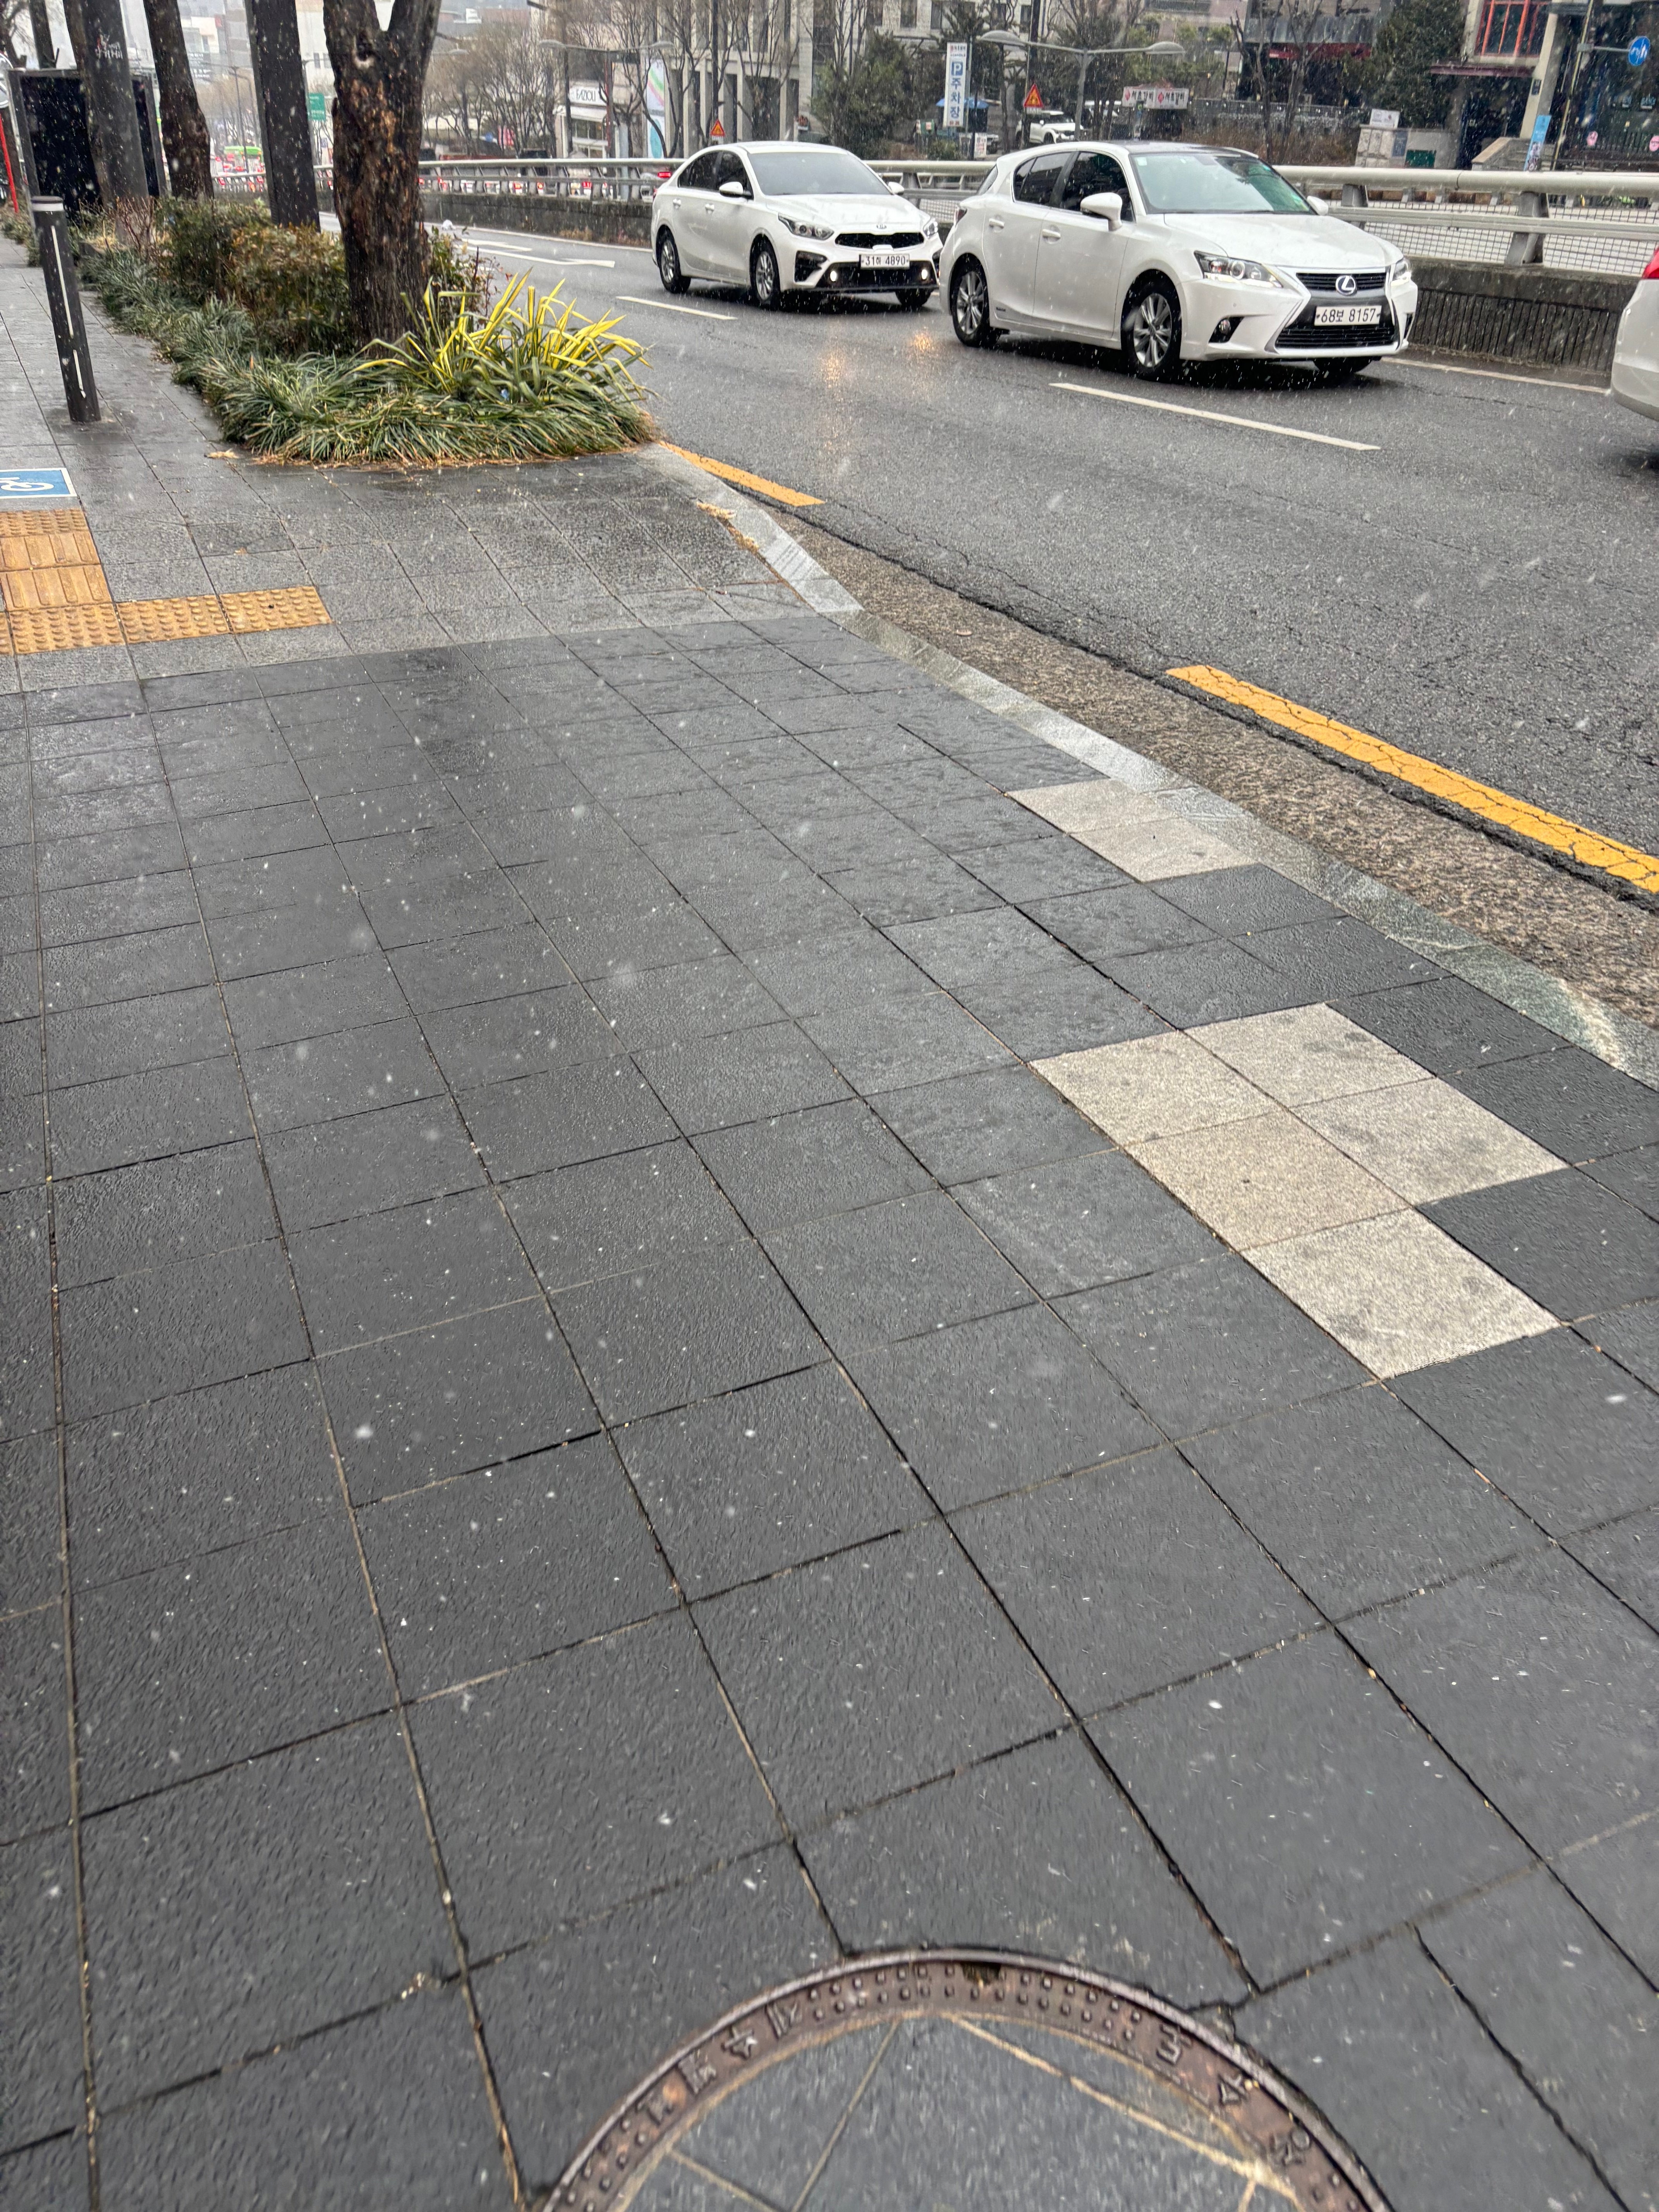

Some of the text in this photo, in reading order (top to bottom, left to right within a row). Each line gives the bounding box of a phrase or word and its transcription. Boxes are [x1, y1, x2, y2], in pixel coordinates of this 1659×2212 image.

[953, 63, 962, 76] P
[950, 78, 961, 118] 주차장
[885, 256, 905, 265] 4890
[1321, 308, 1376, 323] 68보 8157
